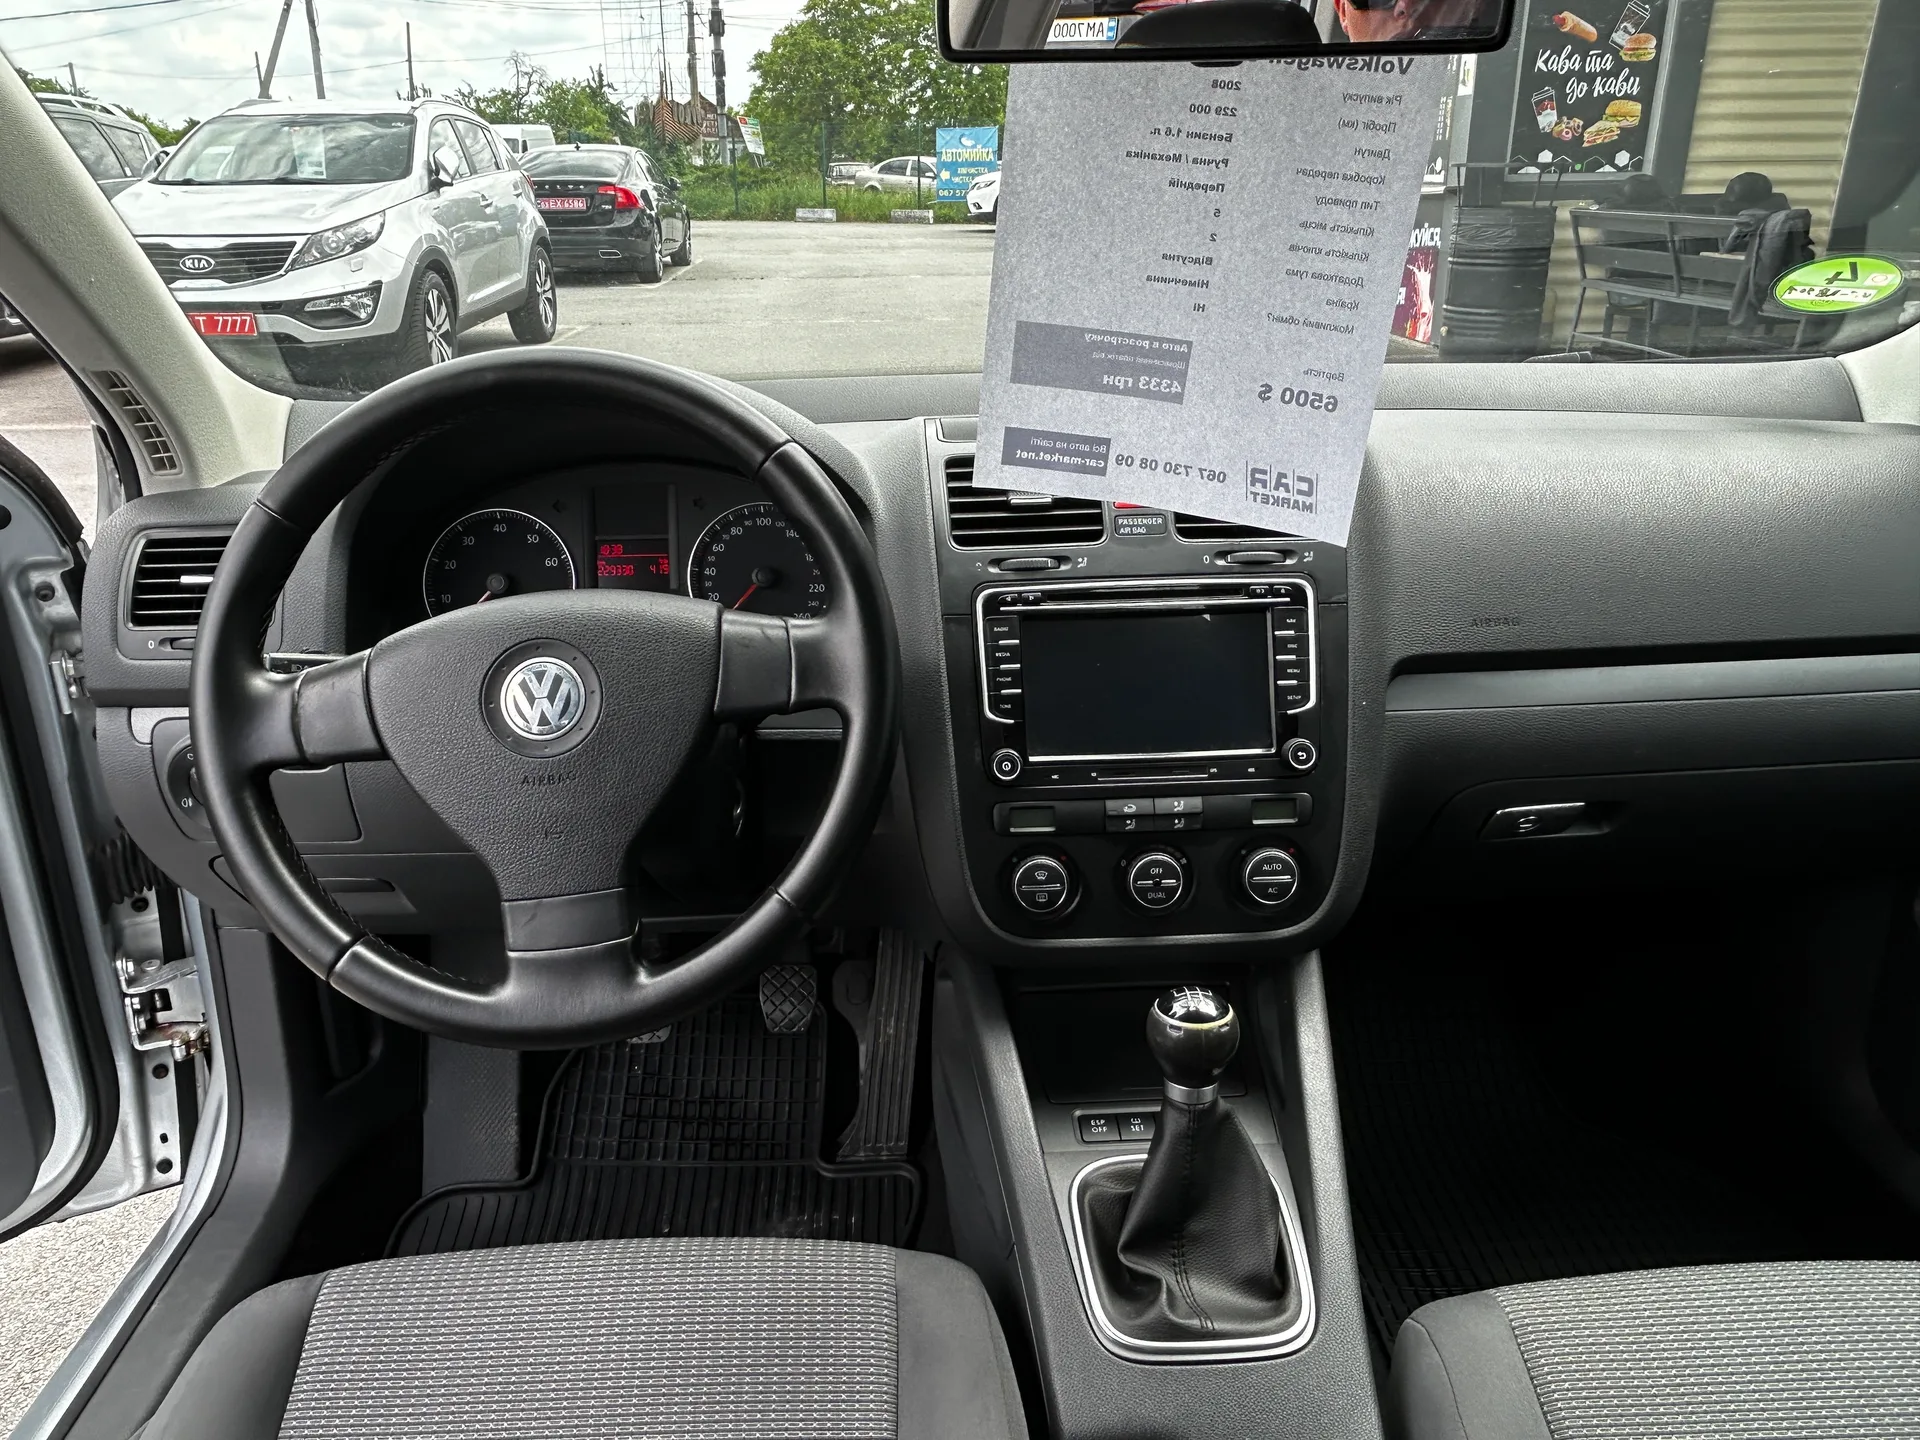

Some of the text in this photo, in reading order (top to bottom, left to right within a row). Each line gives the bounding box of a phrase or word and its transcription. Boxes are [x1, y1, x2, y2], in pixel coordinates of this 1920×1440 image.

[1534, 44, 1583, 75] Кава
[1565, 67, 1641, 105] до кави
[941, 144, 995, 162] АВТОМИЙКА
[184, 259, 209, 269] KIA
[213, 316, 251, 333] 7777
[755, 517, 772, 526] 100
[1117, 517, 1163, 525] PASSENGER
[493, 523, 507, 532] 40
[730, 527, 743, 535] 80
[462, 536, 475, 545] 30
[527, 534, 539, 543] 50
[712, 544, 725, 552] 60
[445, 560, 457, 569] 20
[545, 557, 558, 567] 60
[704, 567, 716, 576] 40
[808, 584, 825, 592] 220
[1150, 867, 1163, 875] OFF
[1262, 863, 1282, 871] AUTO
